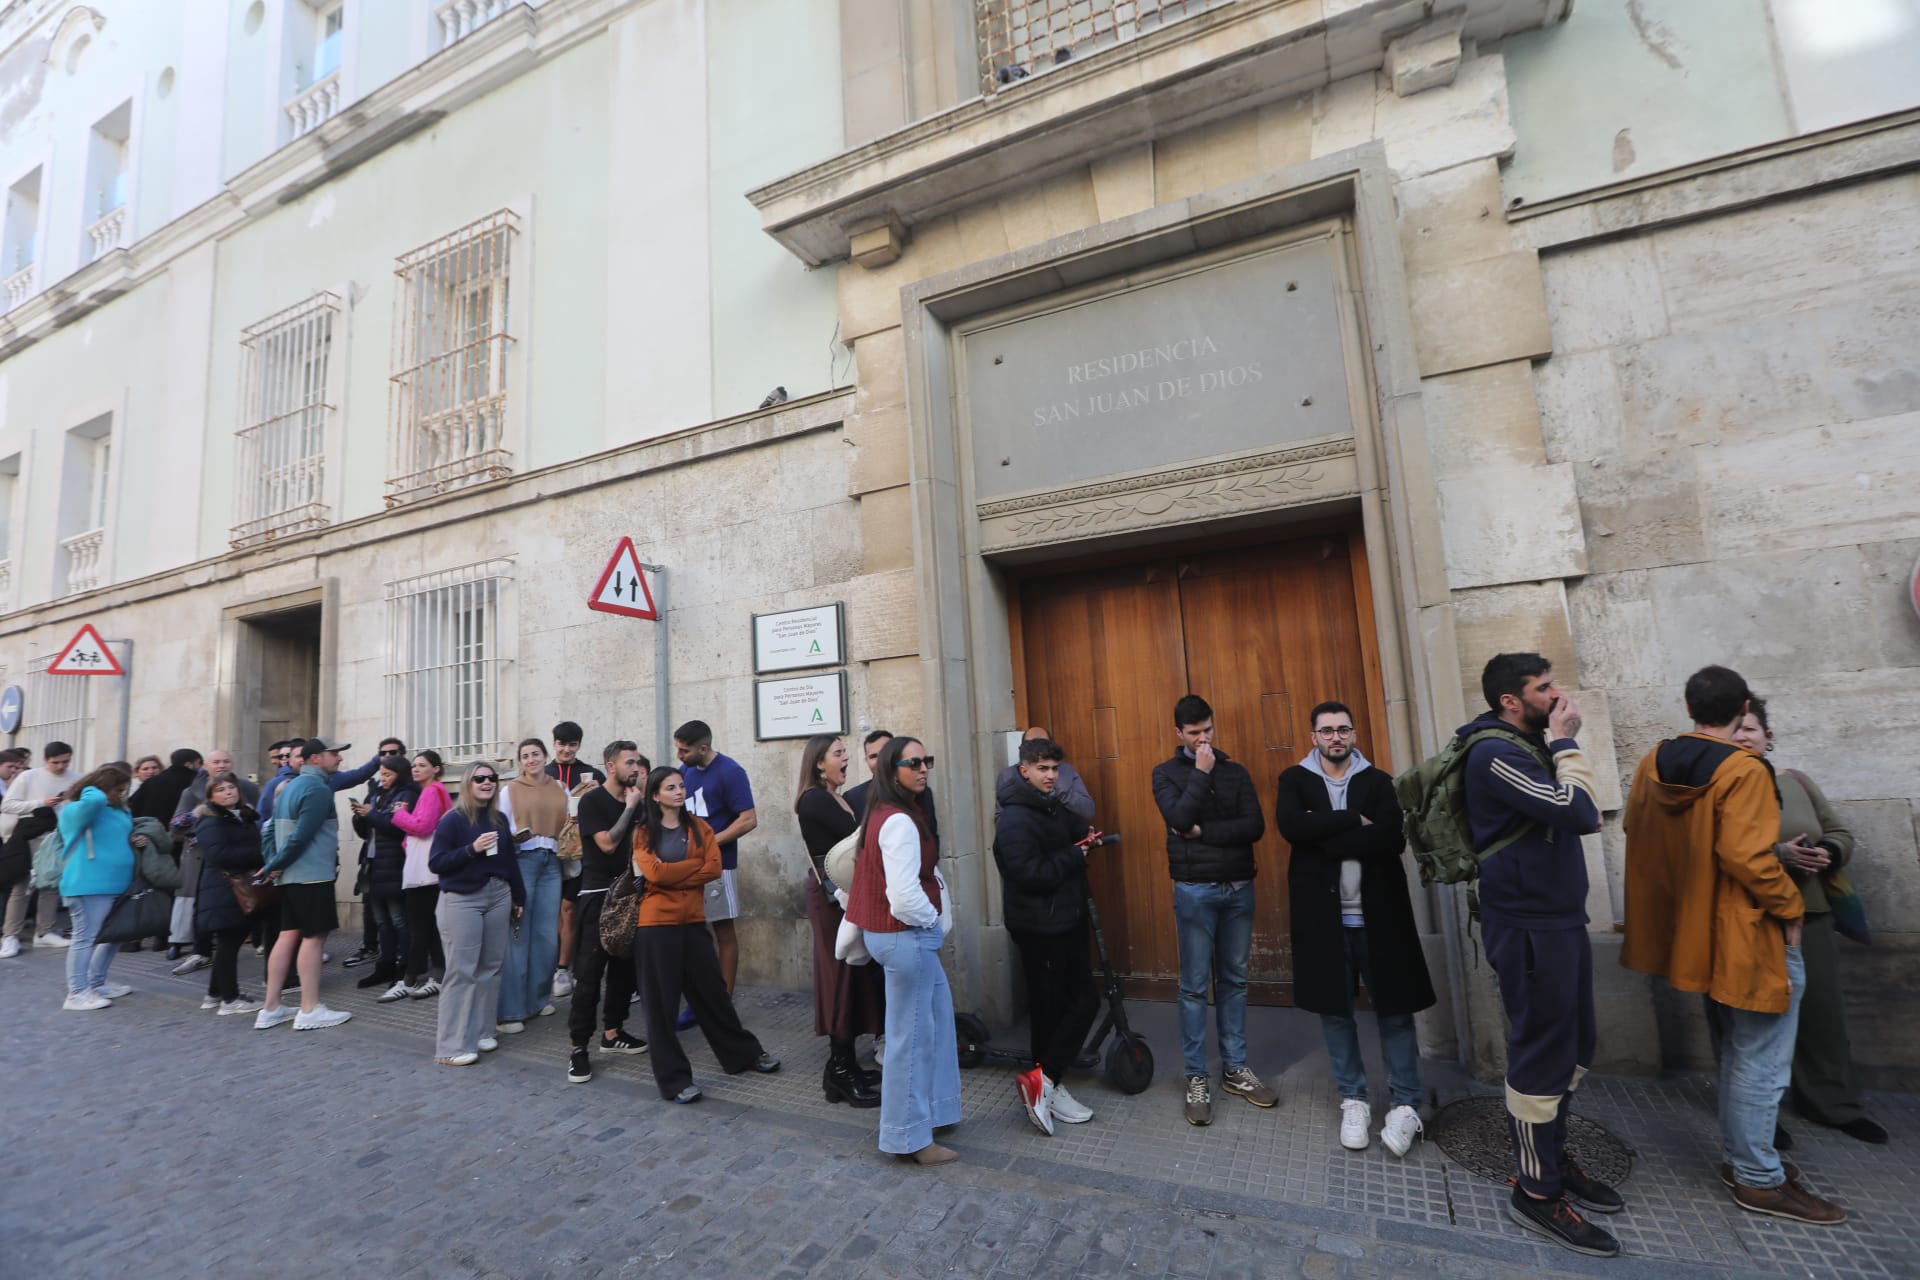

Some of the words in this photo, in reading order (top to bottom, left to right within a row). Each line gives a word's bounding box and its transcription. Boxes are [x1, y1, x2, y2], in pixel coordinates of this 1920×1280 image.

[1068, 335, 1217, 384] RESIDENCIA
[1033, 400, 1080, 427] SAN
[1087, 386, 1150, 416] JUAN
[1158, 377, 1192, 401] DE
[1199, 362, 1263, 392] DIOS
